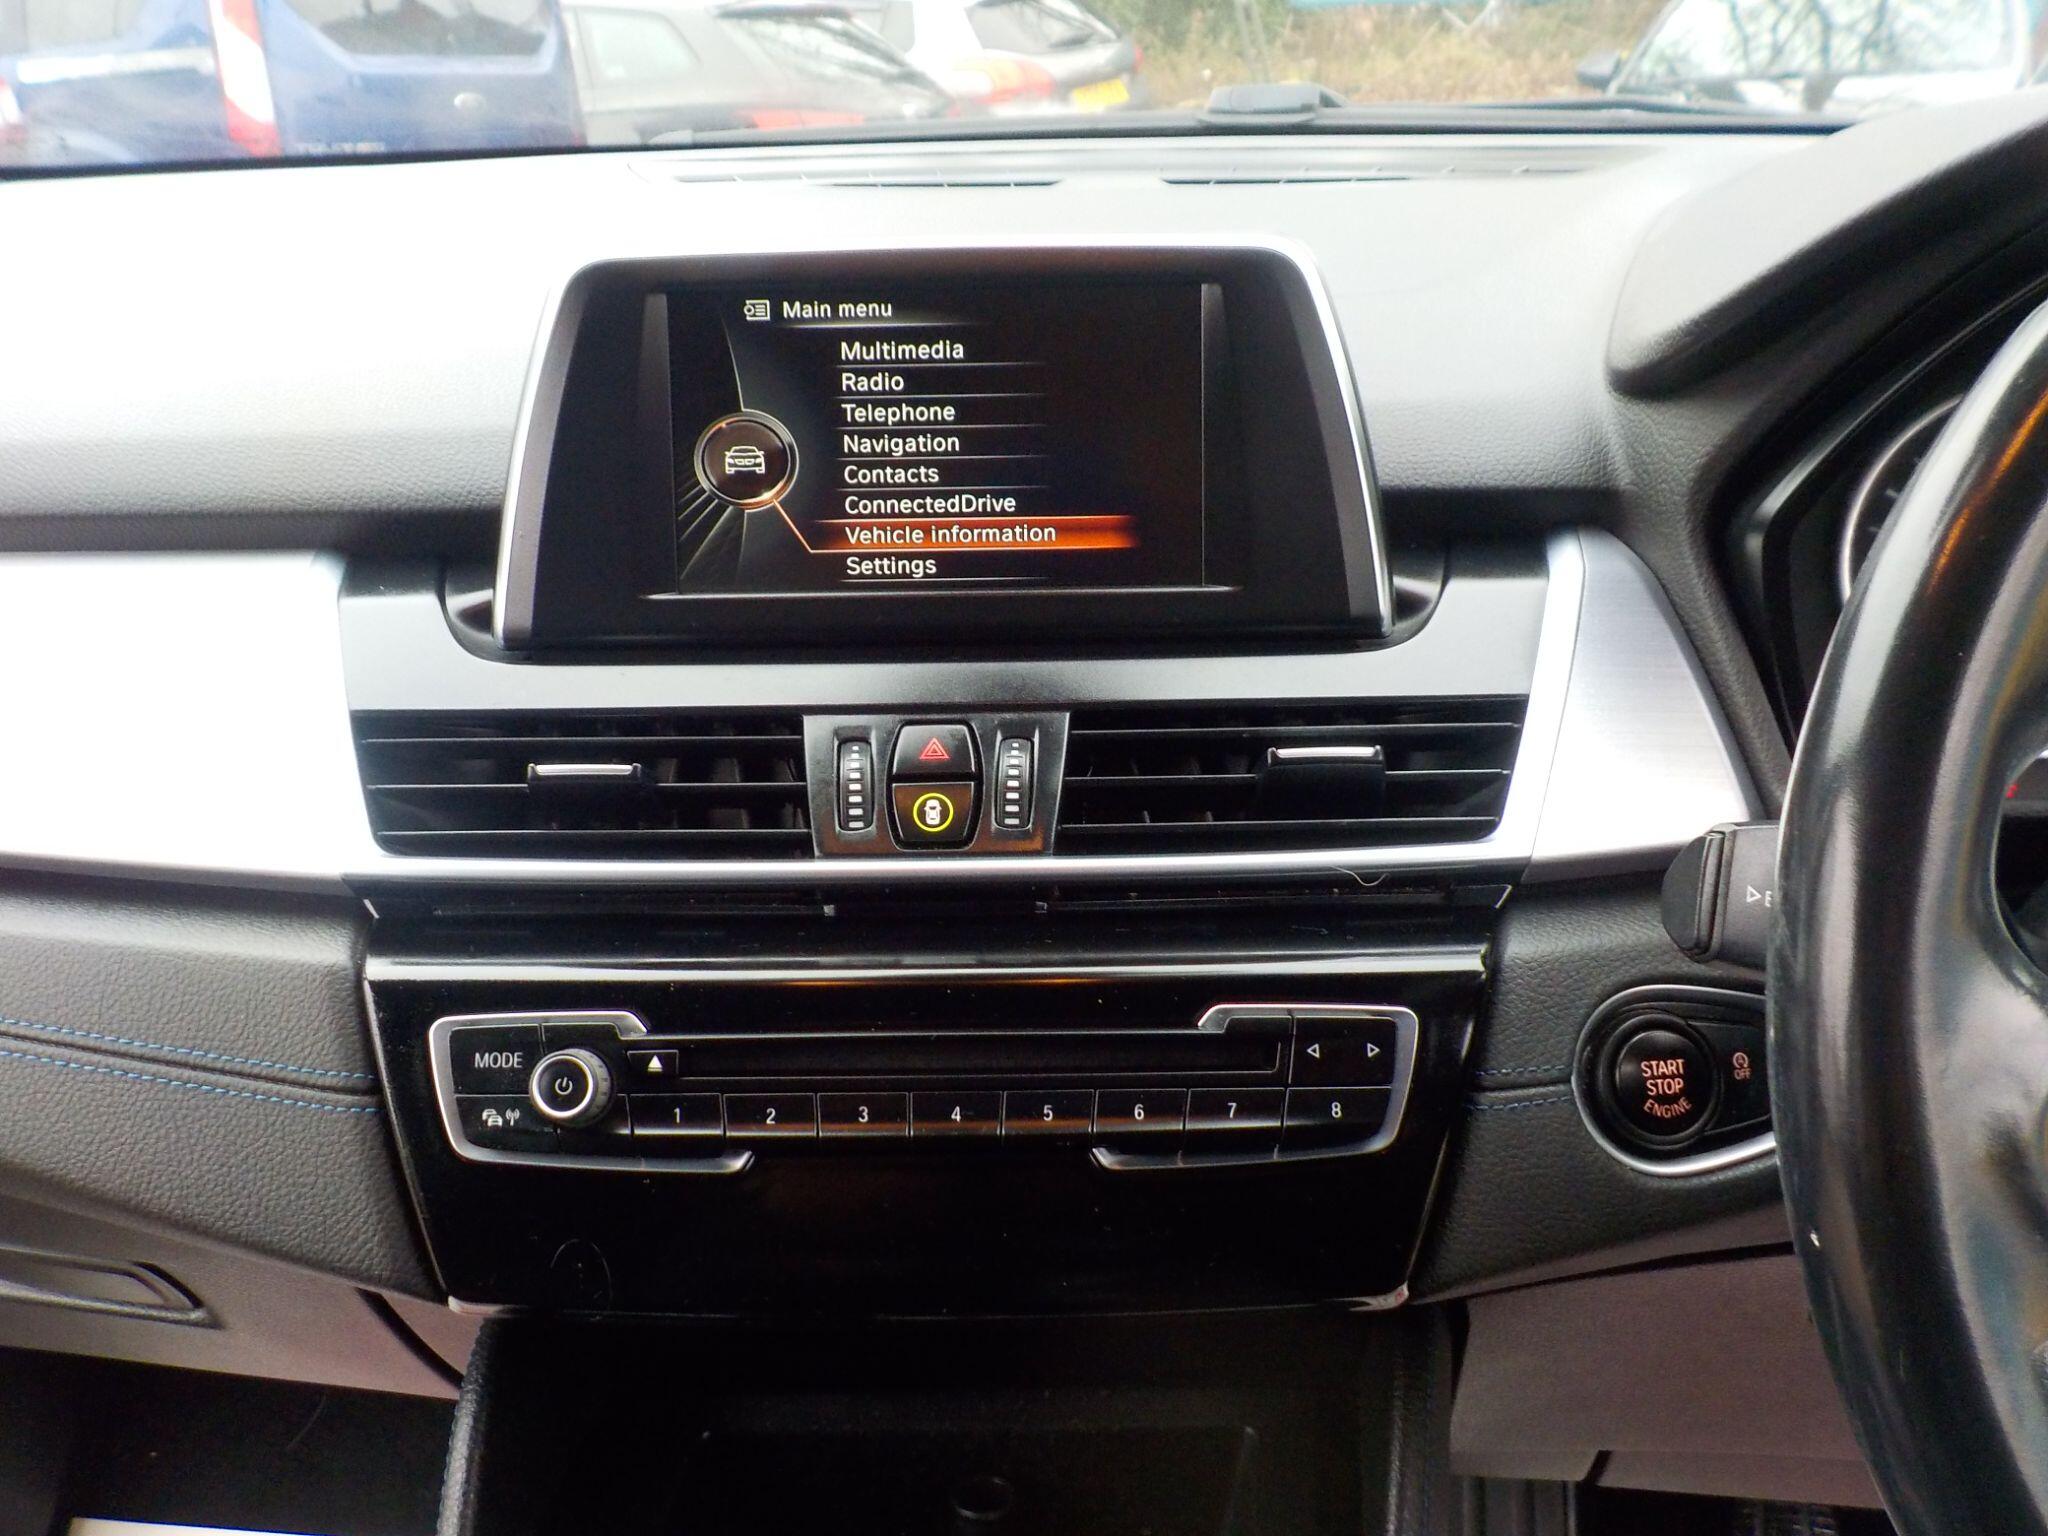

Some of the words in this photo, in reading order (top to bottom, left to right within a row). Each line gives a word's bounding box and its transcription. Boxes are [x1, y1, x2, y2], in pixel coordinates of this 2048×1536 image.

[782, 301, 832, 318] Main
[838, 304, 893, 319] menu
[840, 340, 964, 360] Multimedia
[841, 372, 905, 391] Radio
[842, 403, 956, 425] Telephone
[843, 434, 960, 457] Navigation
[844, 464, 939, 484] Contacts
[844, 494, 1016, 515] ConnectedDrive
[845, 526, 924, 545] Vehicle
[930, 524, 1057, 544] information
[846, 555, 937, 577] Settings
[474, 1052, 523, 1069] MODE
[1641, 1059, 1685, 1077] START
[1734, 1068, 1751, 1080] OFF
[1646, 1078, 1685, 1096] STOP
[673, 1107, 681, 1124] 1
[766, 1108, 776, 1124] 2
[858, 1106, 869, 1123] 3
[950, 1105, 962, 1122] 4
[1043, 1105, 1054, 1121] 5
[1134, 1103, 1144, 1120] 6
[1227, 1102, 1238, 1118] 7
[1331, 1101, 1342, 1119] 8
[1643, 1096, 1692, 1118] ENGINE
